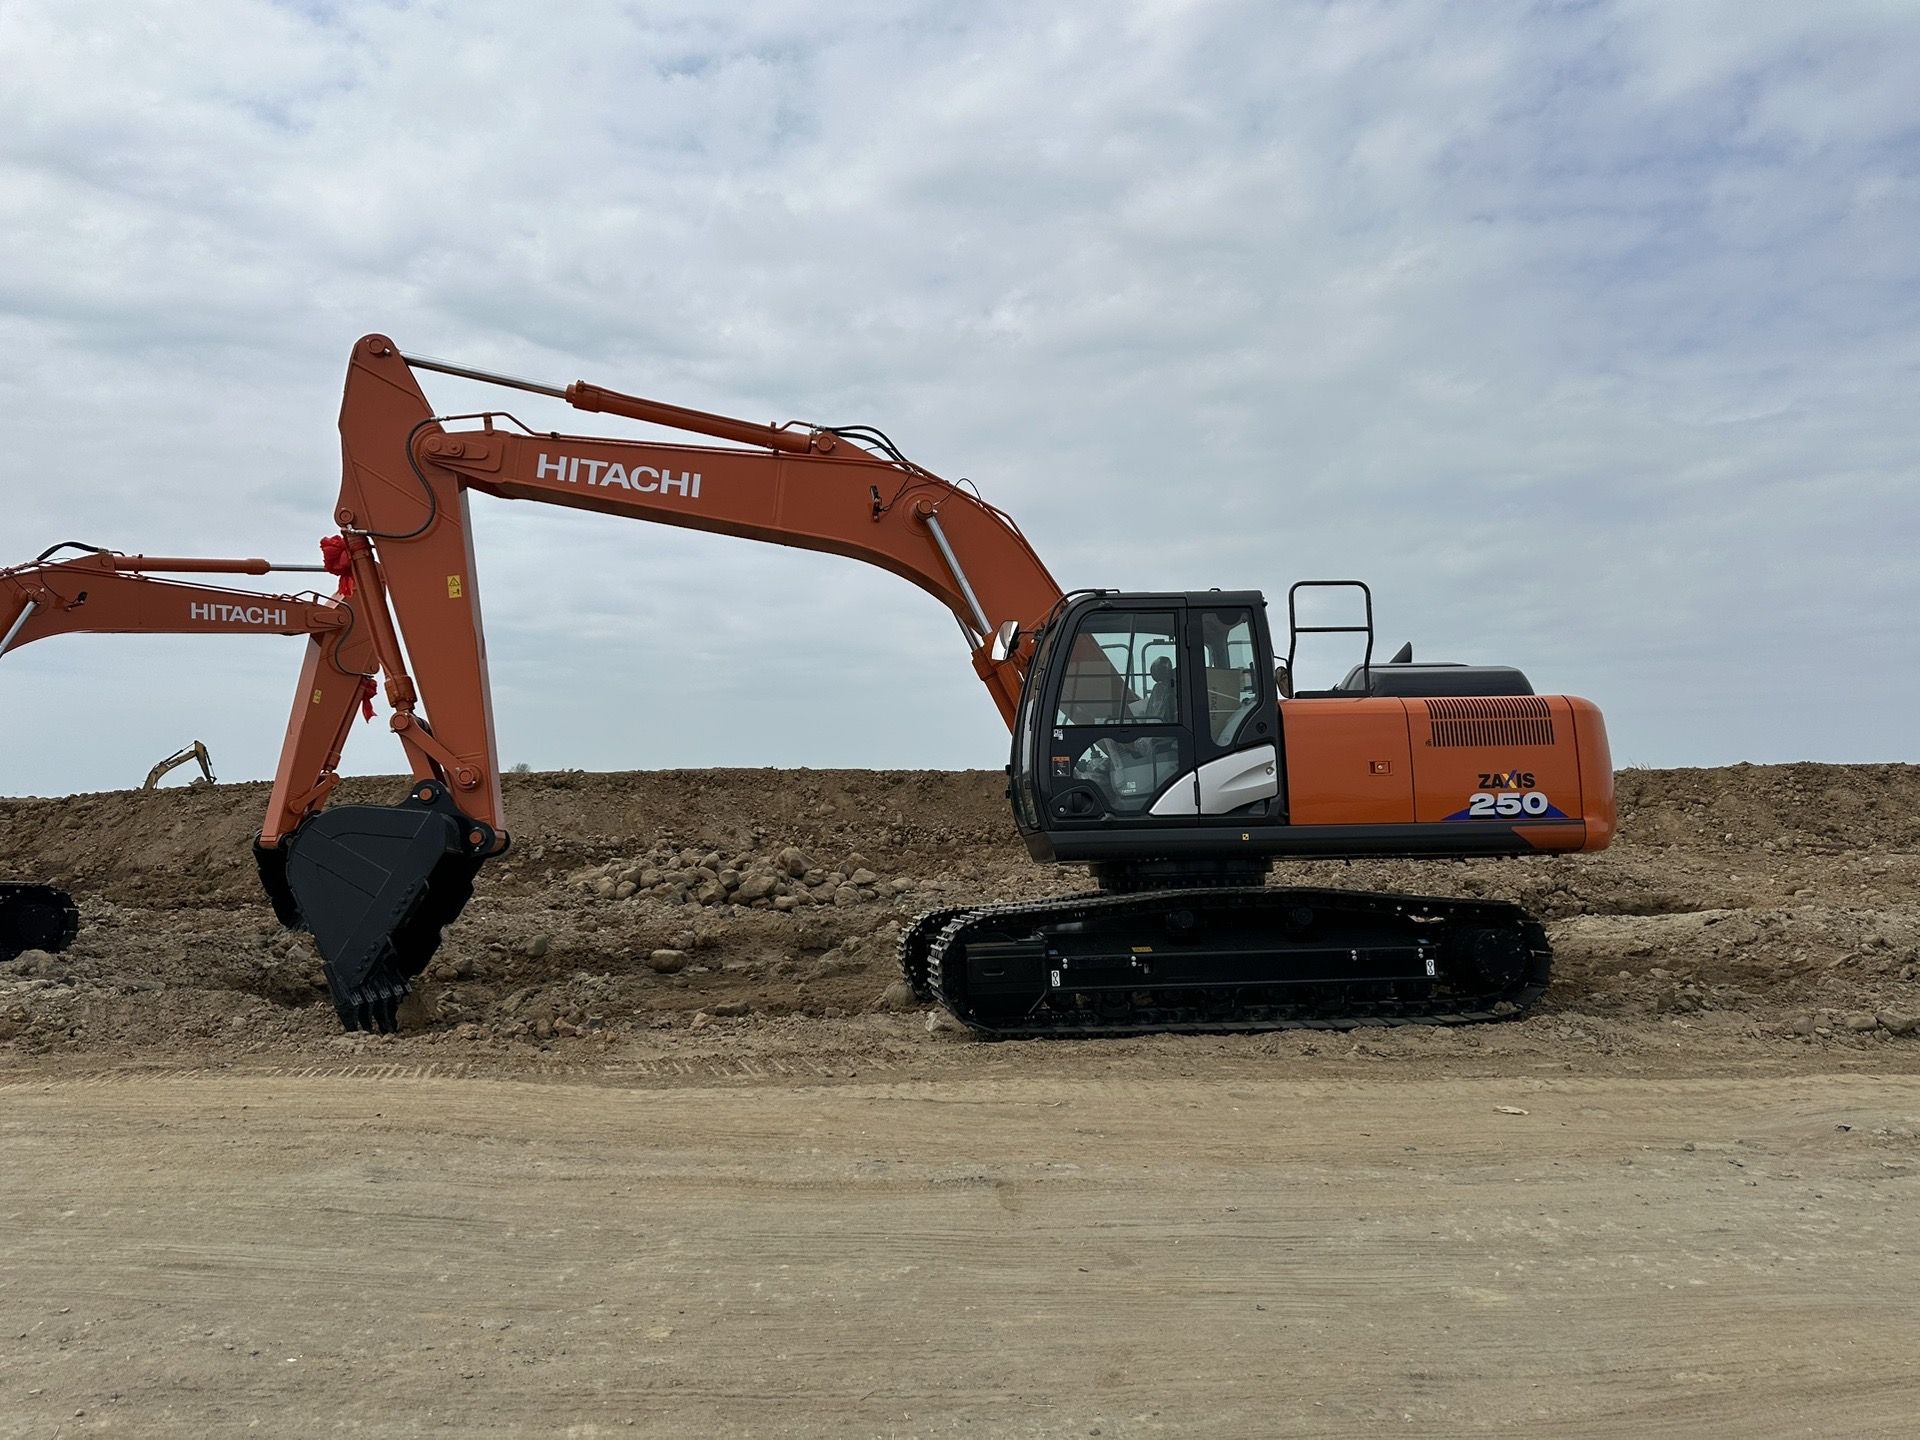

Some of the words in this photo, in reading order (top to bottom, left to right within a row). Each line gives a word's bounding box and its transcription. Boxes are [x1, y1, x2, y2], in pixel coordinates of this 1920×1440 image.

[537, 453, 701, 498] HITACHI
[190, 602, 287, 625] HITACHI
[1478, 769, 1536, 789] ZAXIS
[1469, 792, 1549, 817] 250
